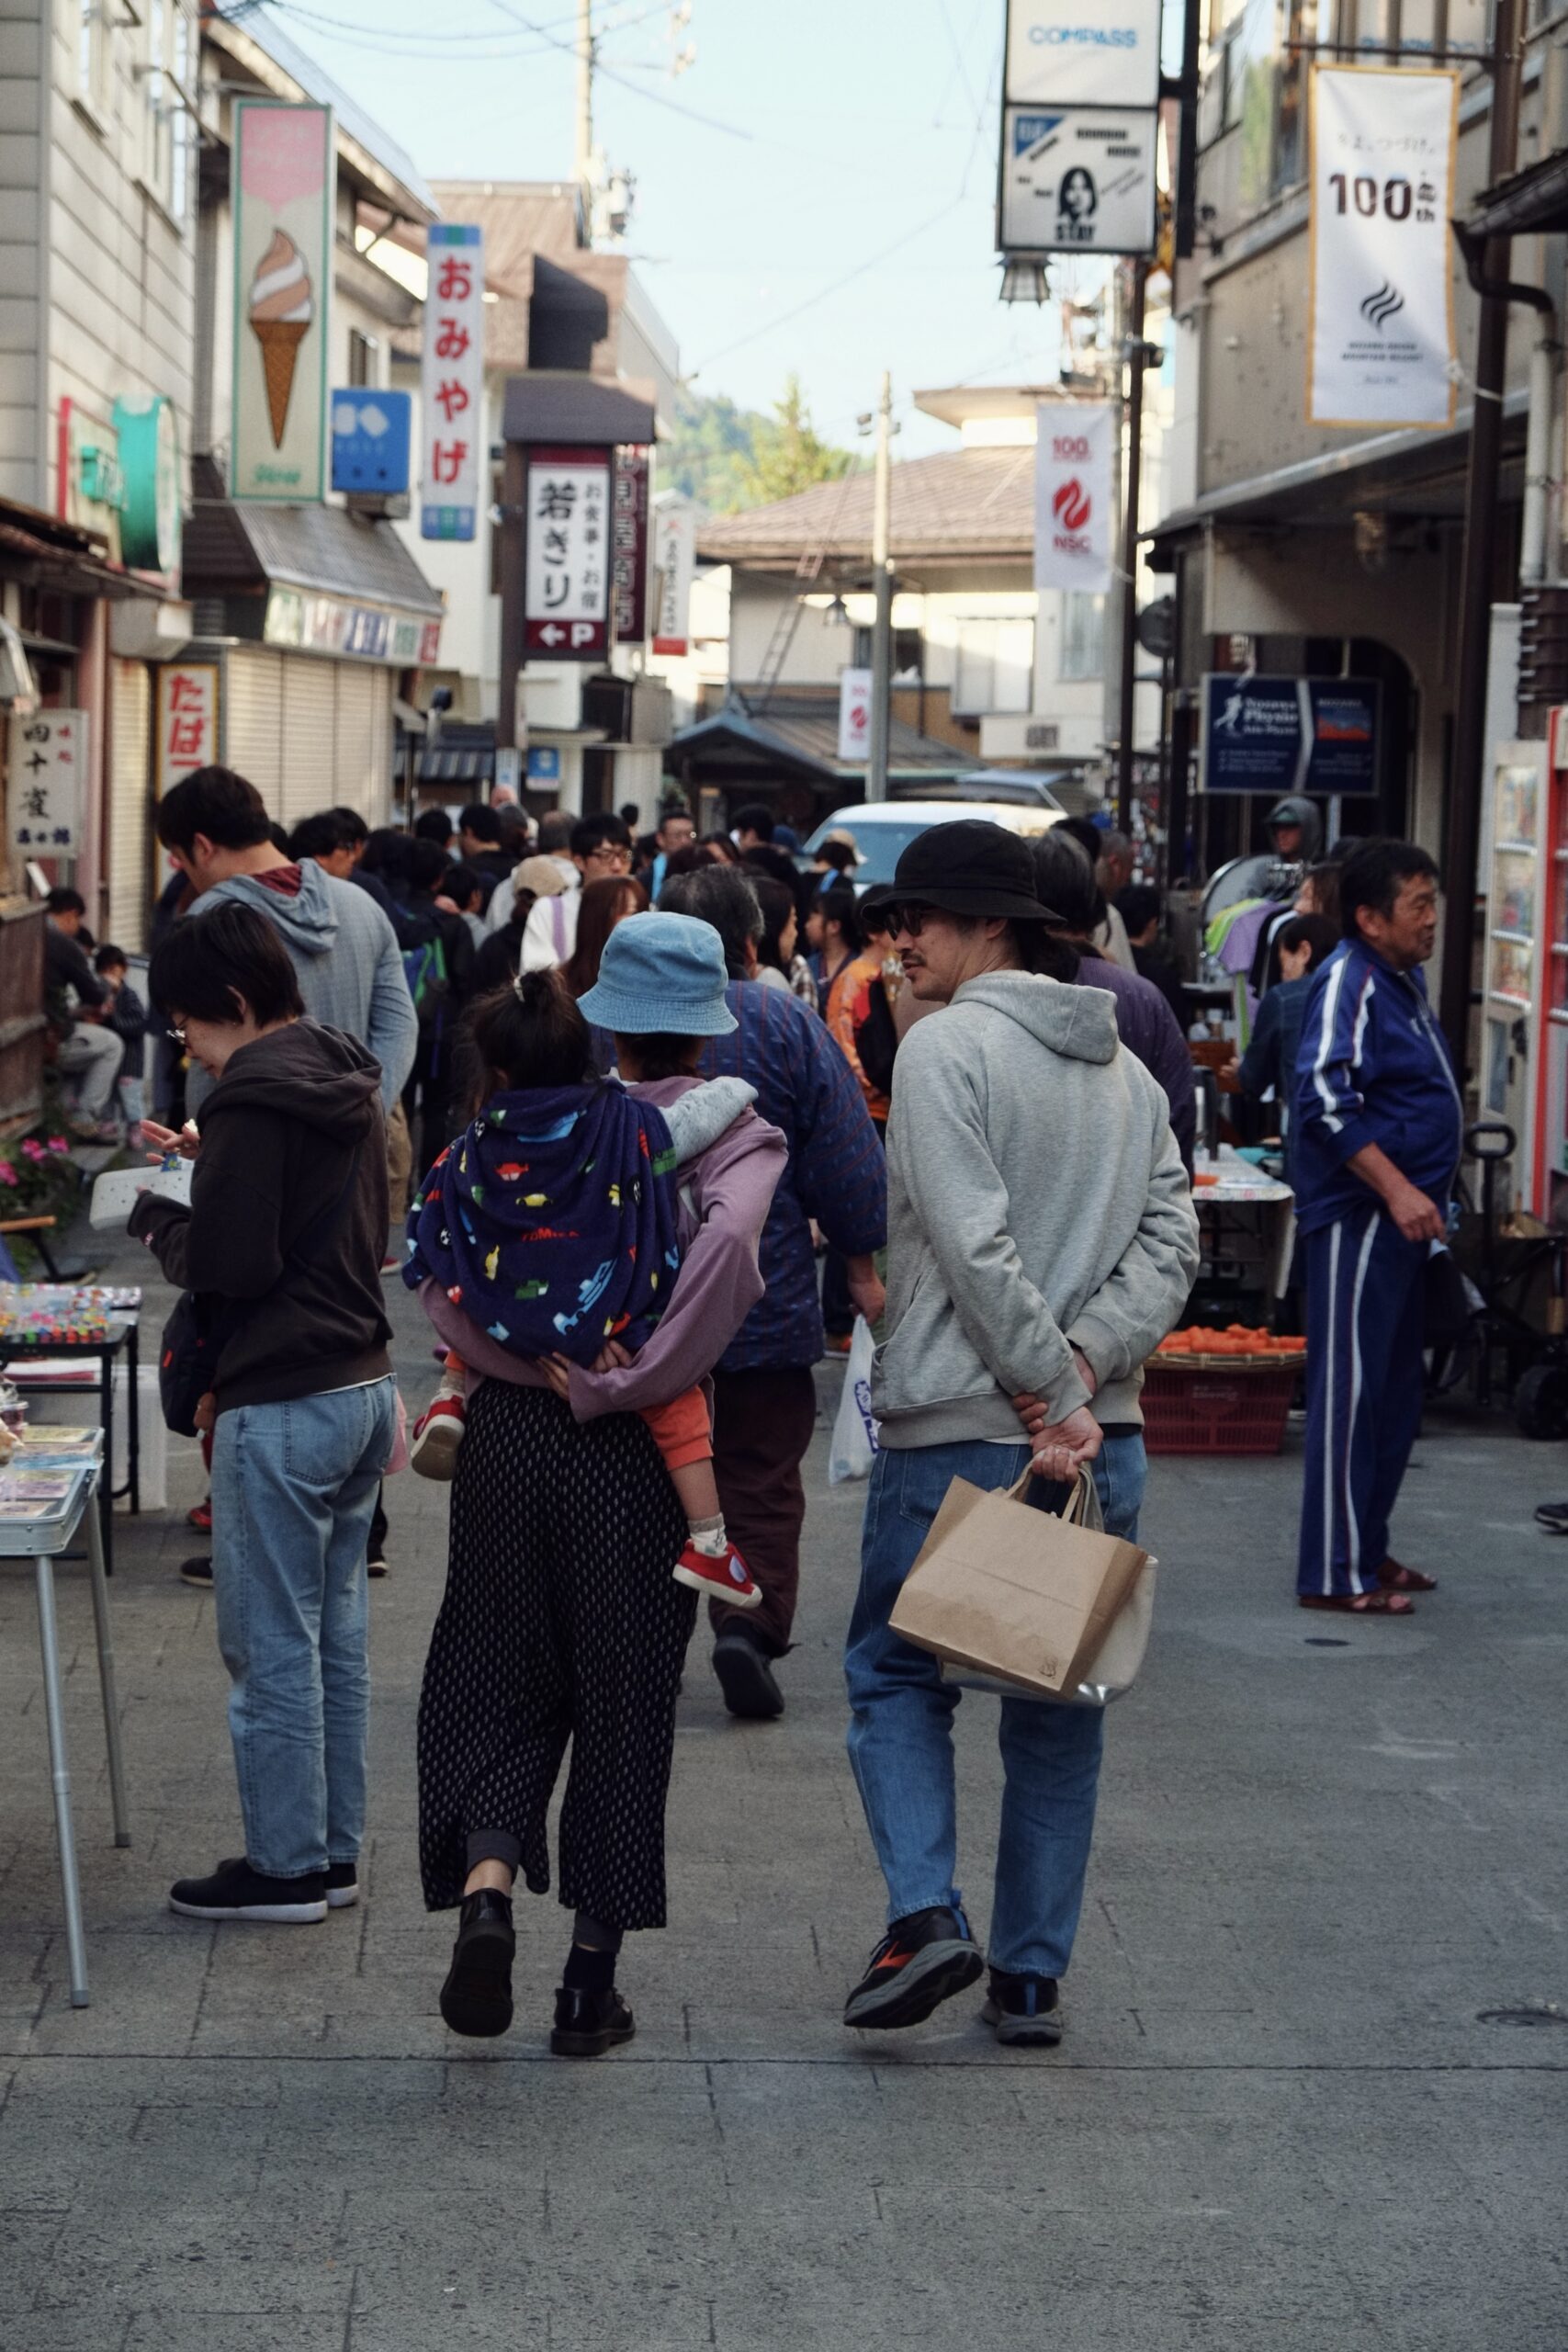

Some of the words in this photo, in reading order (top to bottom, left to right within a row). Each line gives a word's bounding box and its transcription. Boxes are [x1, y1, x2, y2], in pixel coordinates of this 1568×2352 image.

[1029, 27, 1137, 48] COMPASS
[1329, 173, 1412, 221] 100
[433, 254, 471, 484] おみやげ
[1053, 435, 1089, 455] 100
[571, 623, 595, 648] P
